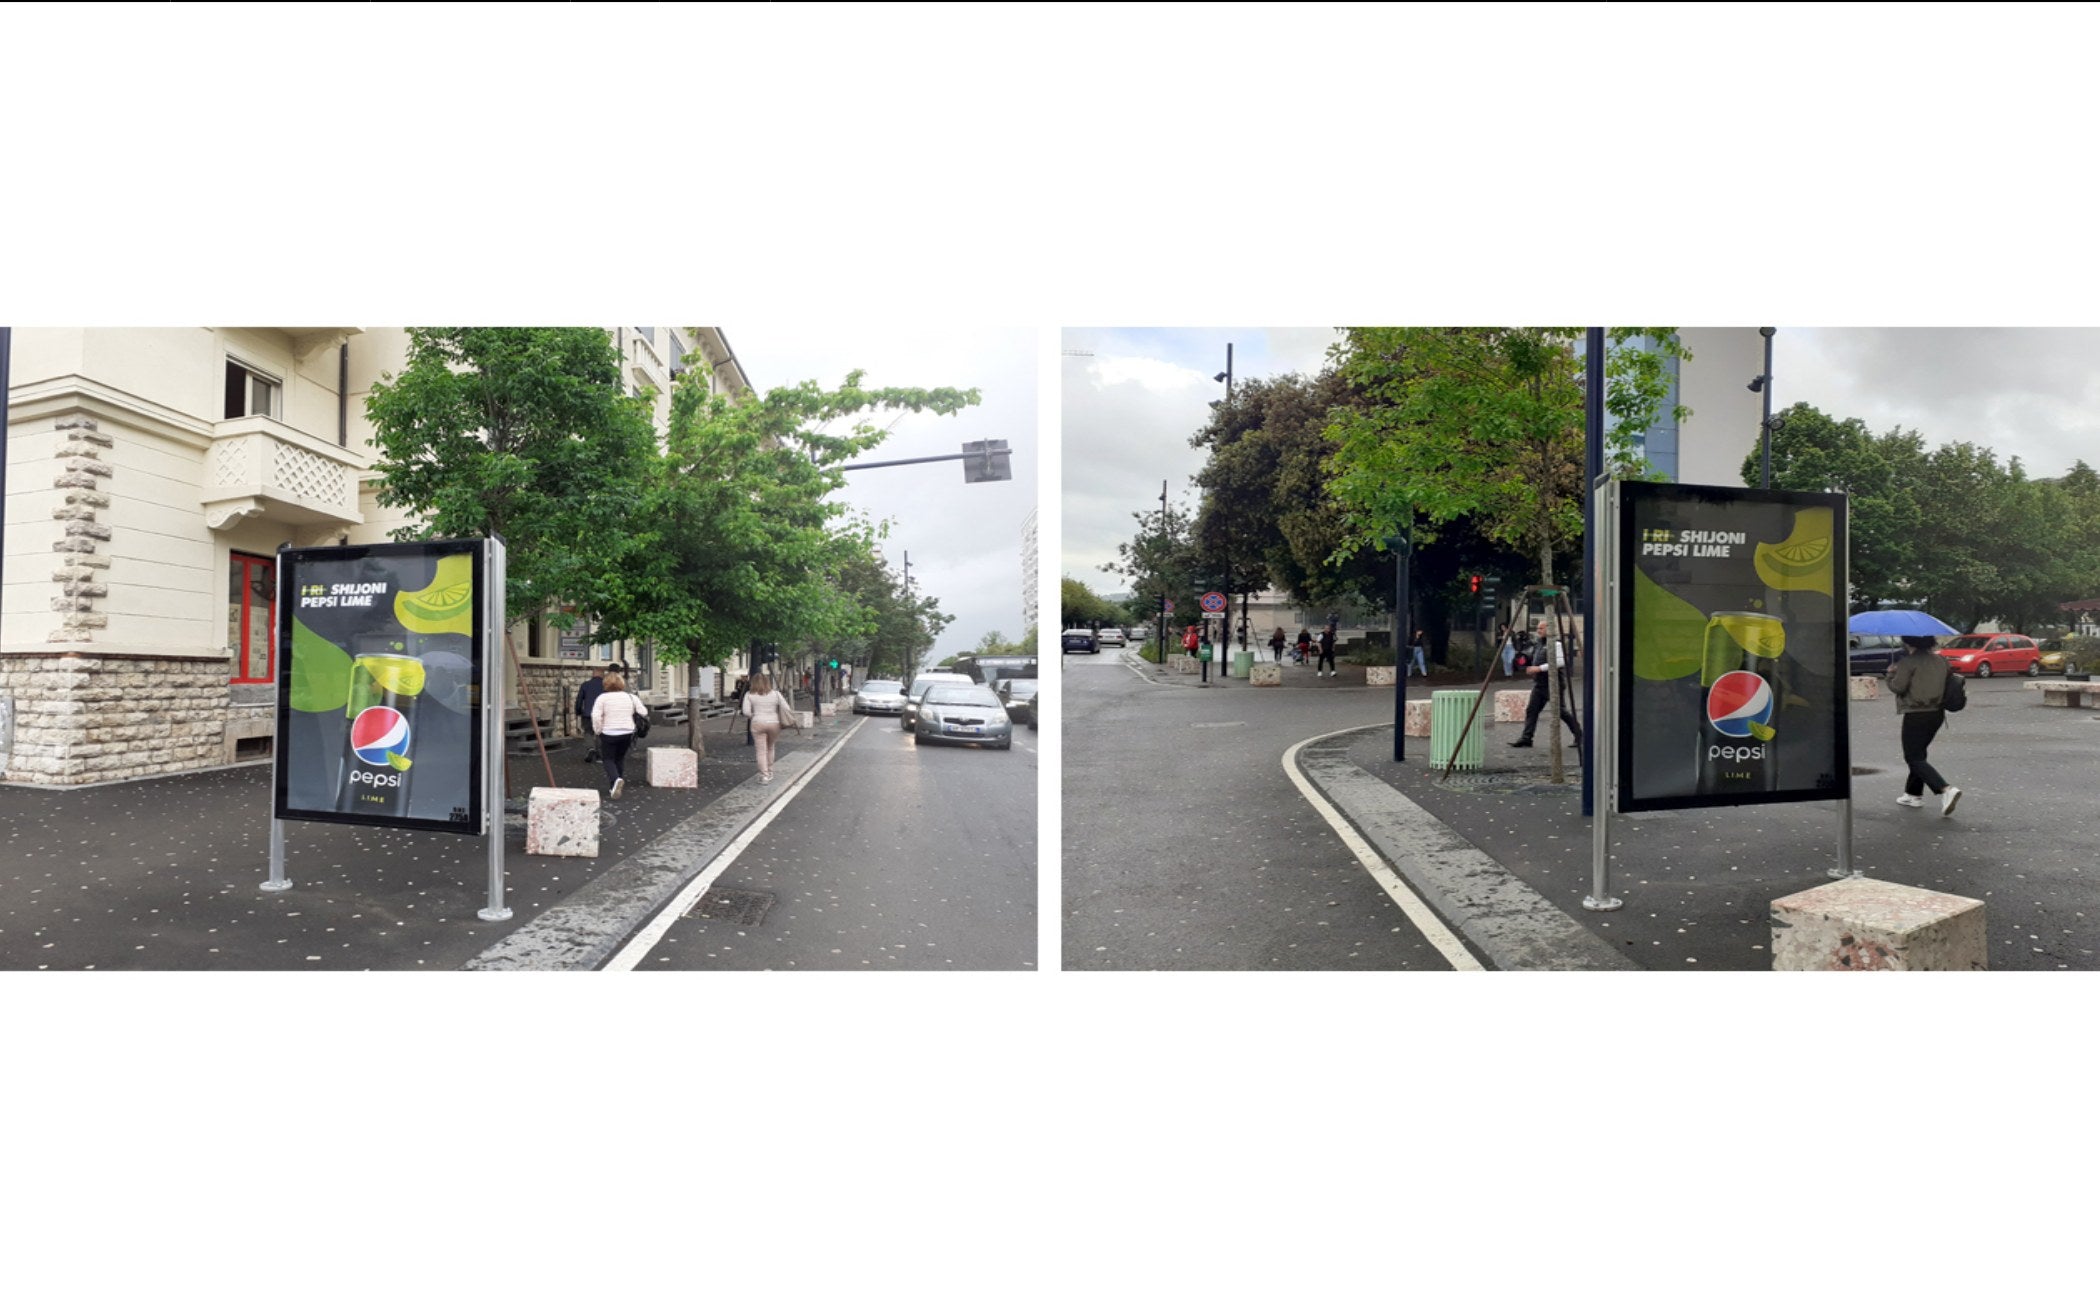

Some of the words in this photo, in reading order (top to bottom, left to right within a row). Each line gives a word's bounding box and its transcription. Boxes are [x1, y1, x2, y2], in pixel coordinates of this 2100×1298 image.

[1652, 529, 1670, 542] RI
[1679, 529, 1746, 545] SHIJONI
[1642, 543, 1689, 557] PEPSI
[1692, 544, 1731, 558] LIME
[310, 585, 324, 596] RI
[330, 582, 387, 595] SHIJONI
[301, 596, 338, 608] PEPSI
[340, 595, 373, 607] LIME
[1708, 743, 1766, 763] pepsi
[349, 769, 402, 788] pepsi
[1725, 772, 1752, 780] LIME
[361, 794, 385, 803] LIME
